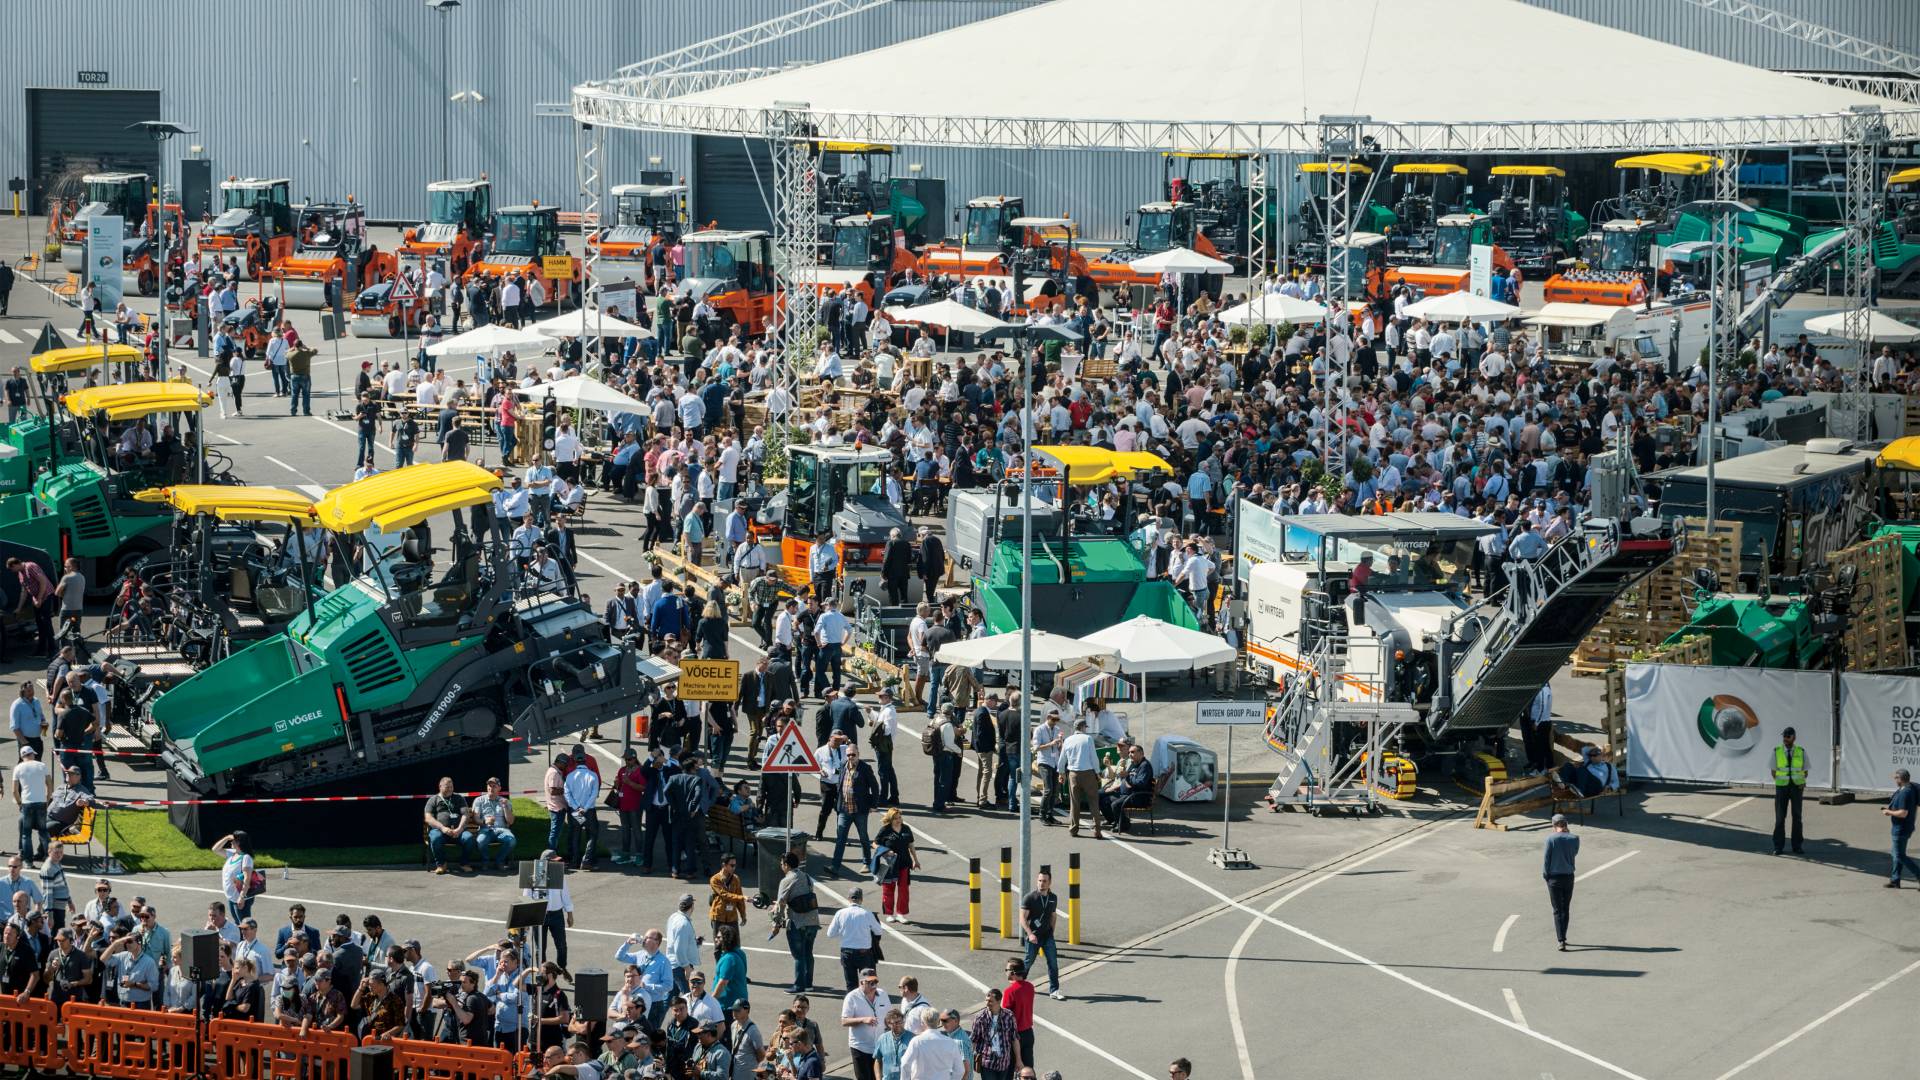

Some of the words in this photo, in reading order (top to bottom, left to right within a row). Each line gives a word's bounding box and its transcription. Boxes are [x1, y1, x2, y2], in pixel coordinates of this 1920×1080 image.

[79, 73, 106, 82] TOR28
[1393, 541, 1430, 549] WIRTGEN
[1264, 603, 1285, 619] WIRTGEN
[686, 664, 733, 679] VÖGELE
[417, 710, 442, 738] SUPER
[437, 683, 462, 711] 1900-3
[1201, 709, 1225, 717] WIRTGEN
[1226, 709, 1244, 717] GROUP
[1246, 709, 1261, 717] Plaza
[288, 710, 324, 727] VÖGELE
[1892, 719, 1920, 732] TEC
[1892, 732, 1920, 745] DAY
[1892, 755, 1904, 765] BY
[1906, 756, 1920, 766] WI
